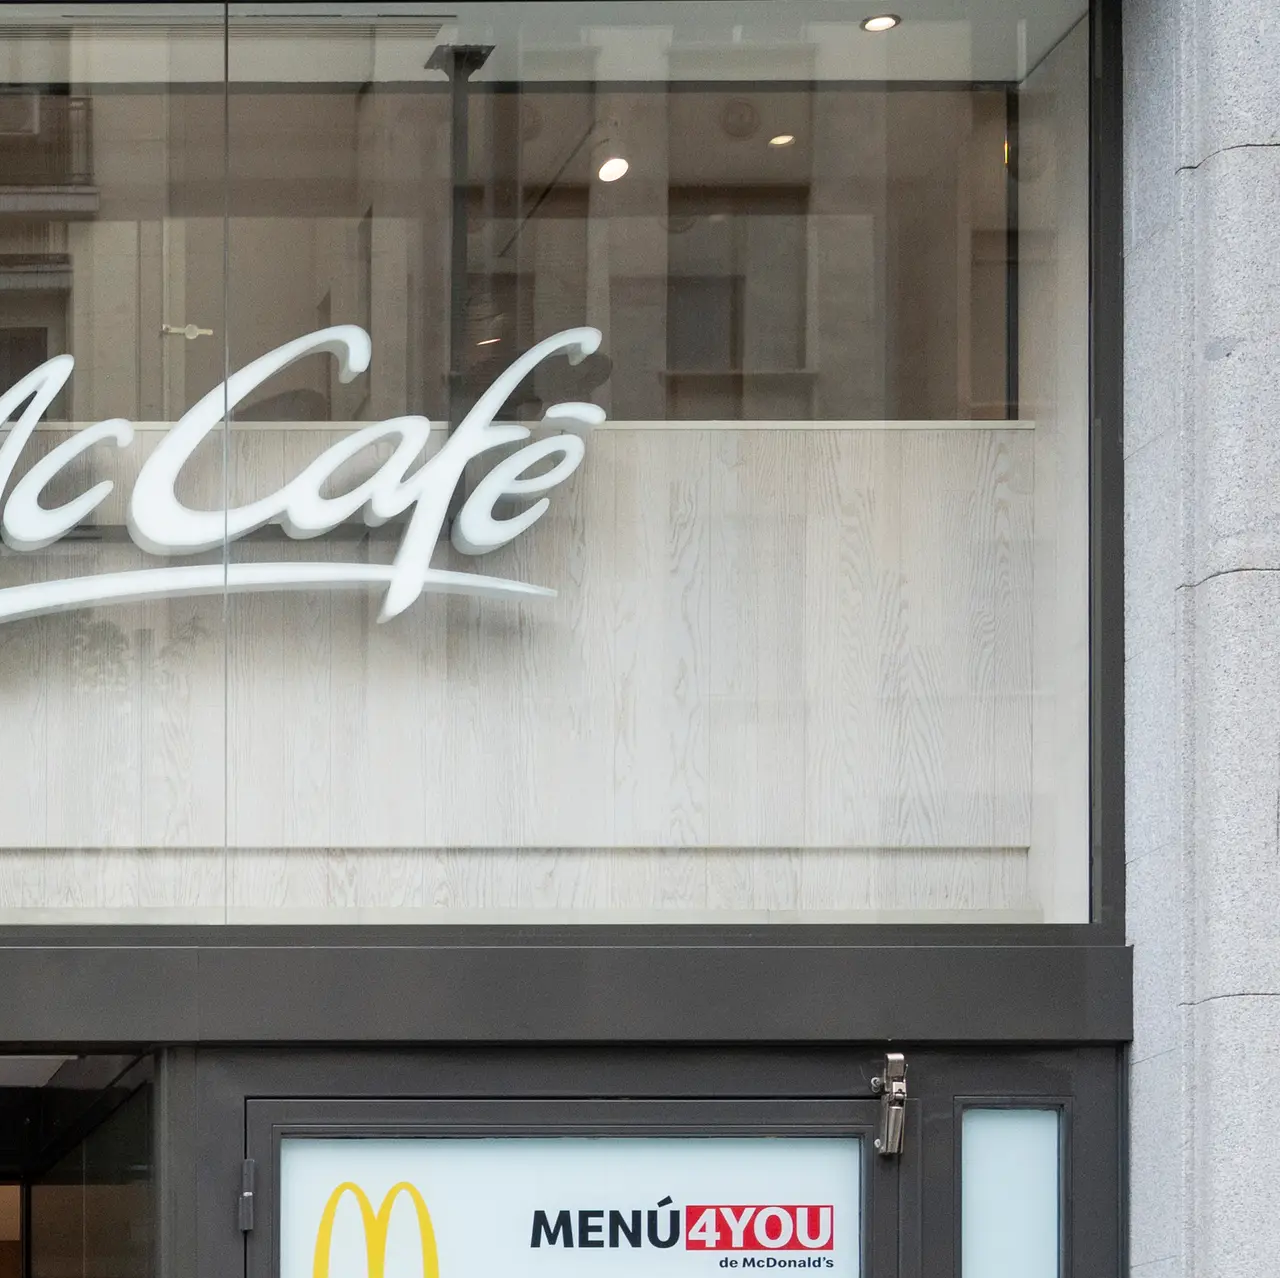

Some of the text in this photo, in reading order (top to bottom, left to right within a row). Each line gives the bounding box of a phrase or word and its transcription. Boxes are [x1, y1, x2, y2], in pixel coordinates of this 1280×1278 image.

[530, 1195, 832, 1249] MENÚ 4YOU
[719, 1256, 834, 1268] de McDonald’s
